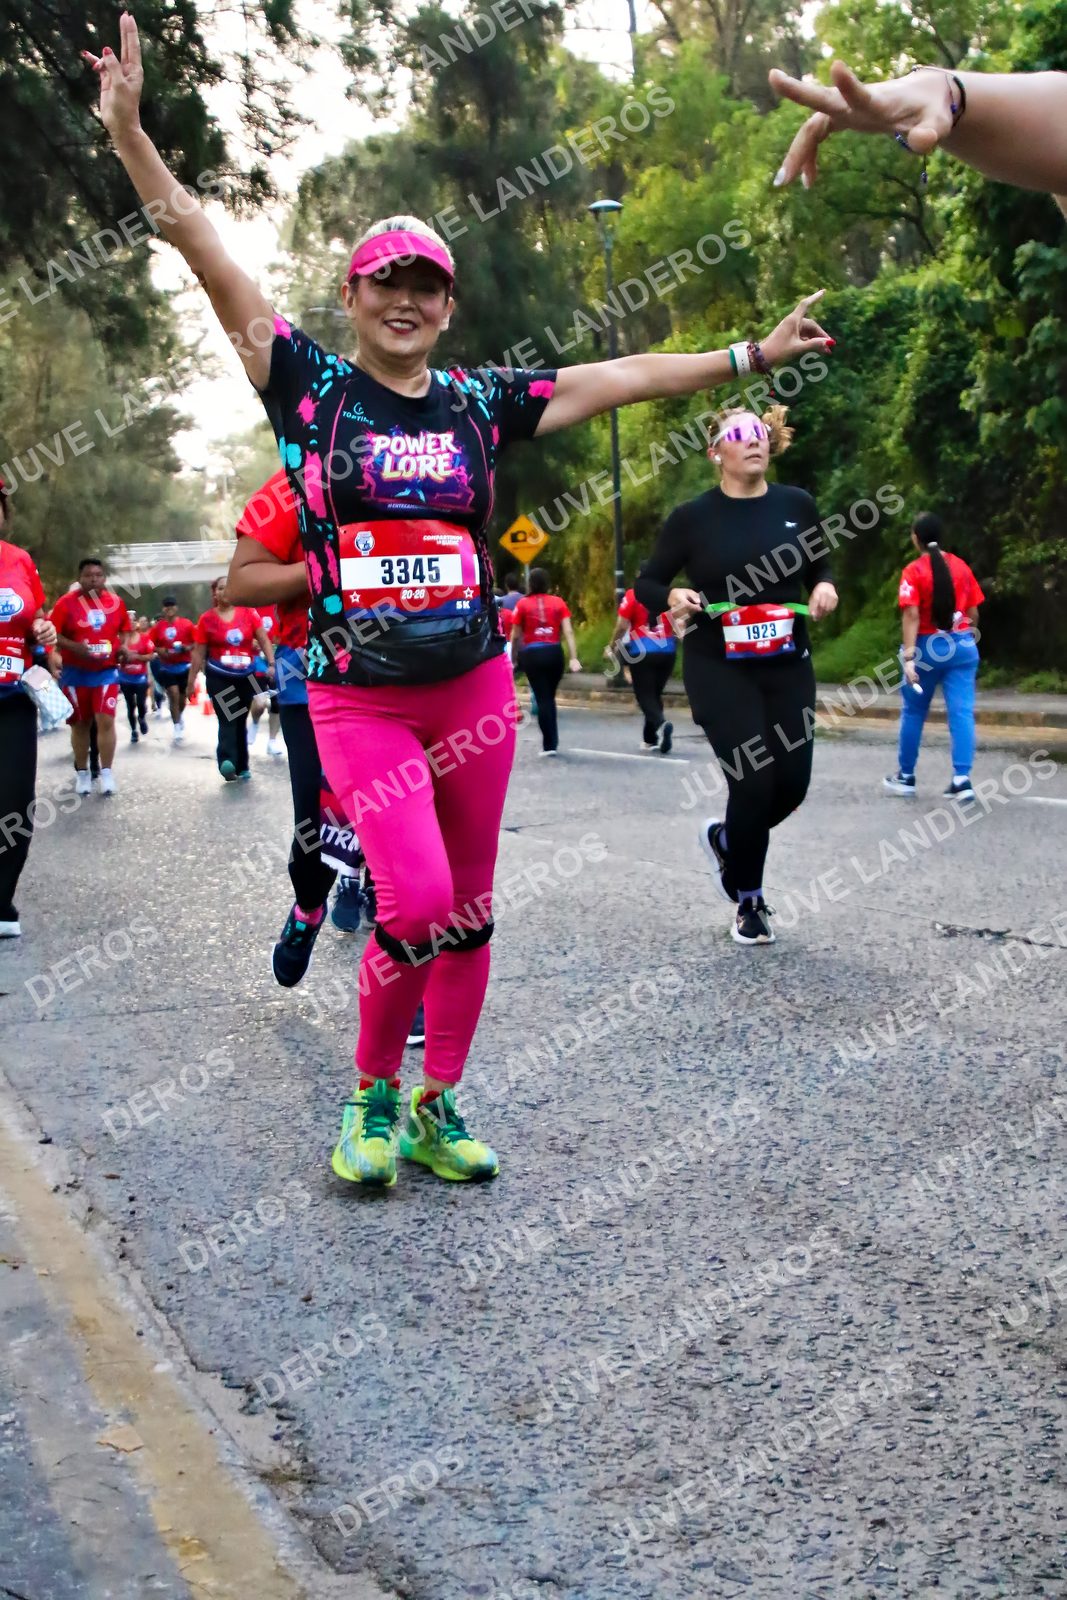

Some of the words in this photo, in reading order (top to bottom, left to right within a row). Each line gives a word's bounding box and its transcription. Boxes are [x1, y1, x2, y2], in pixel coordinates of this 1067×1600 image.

[371, 431, 462, 455] POWER
[381, 453, 456, 483] LORE
[380, 557, 441, 585] 3345
[456, 600, 471, 610] 5K
[746, 623, 777, 640] 1923
